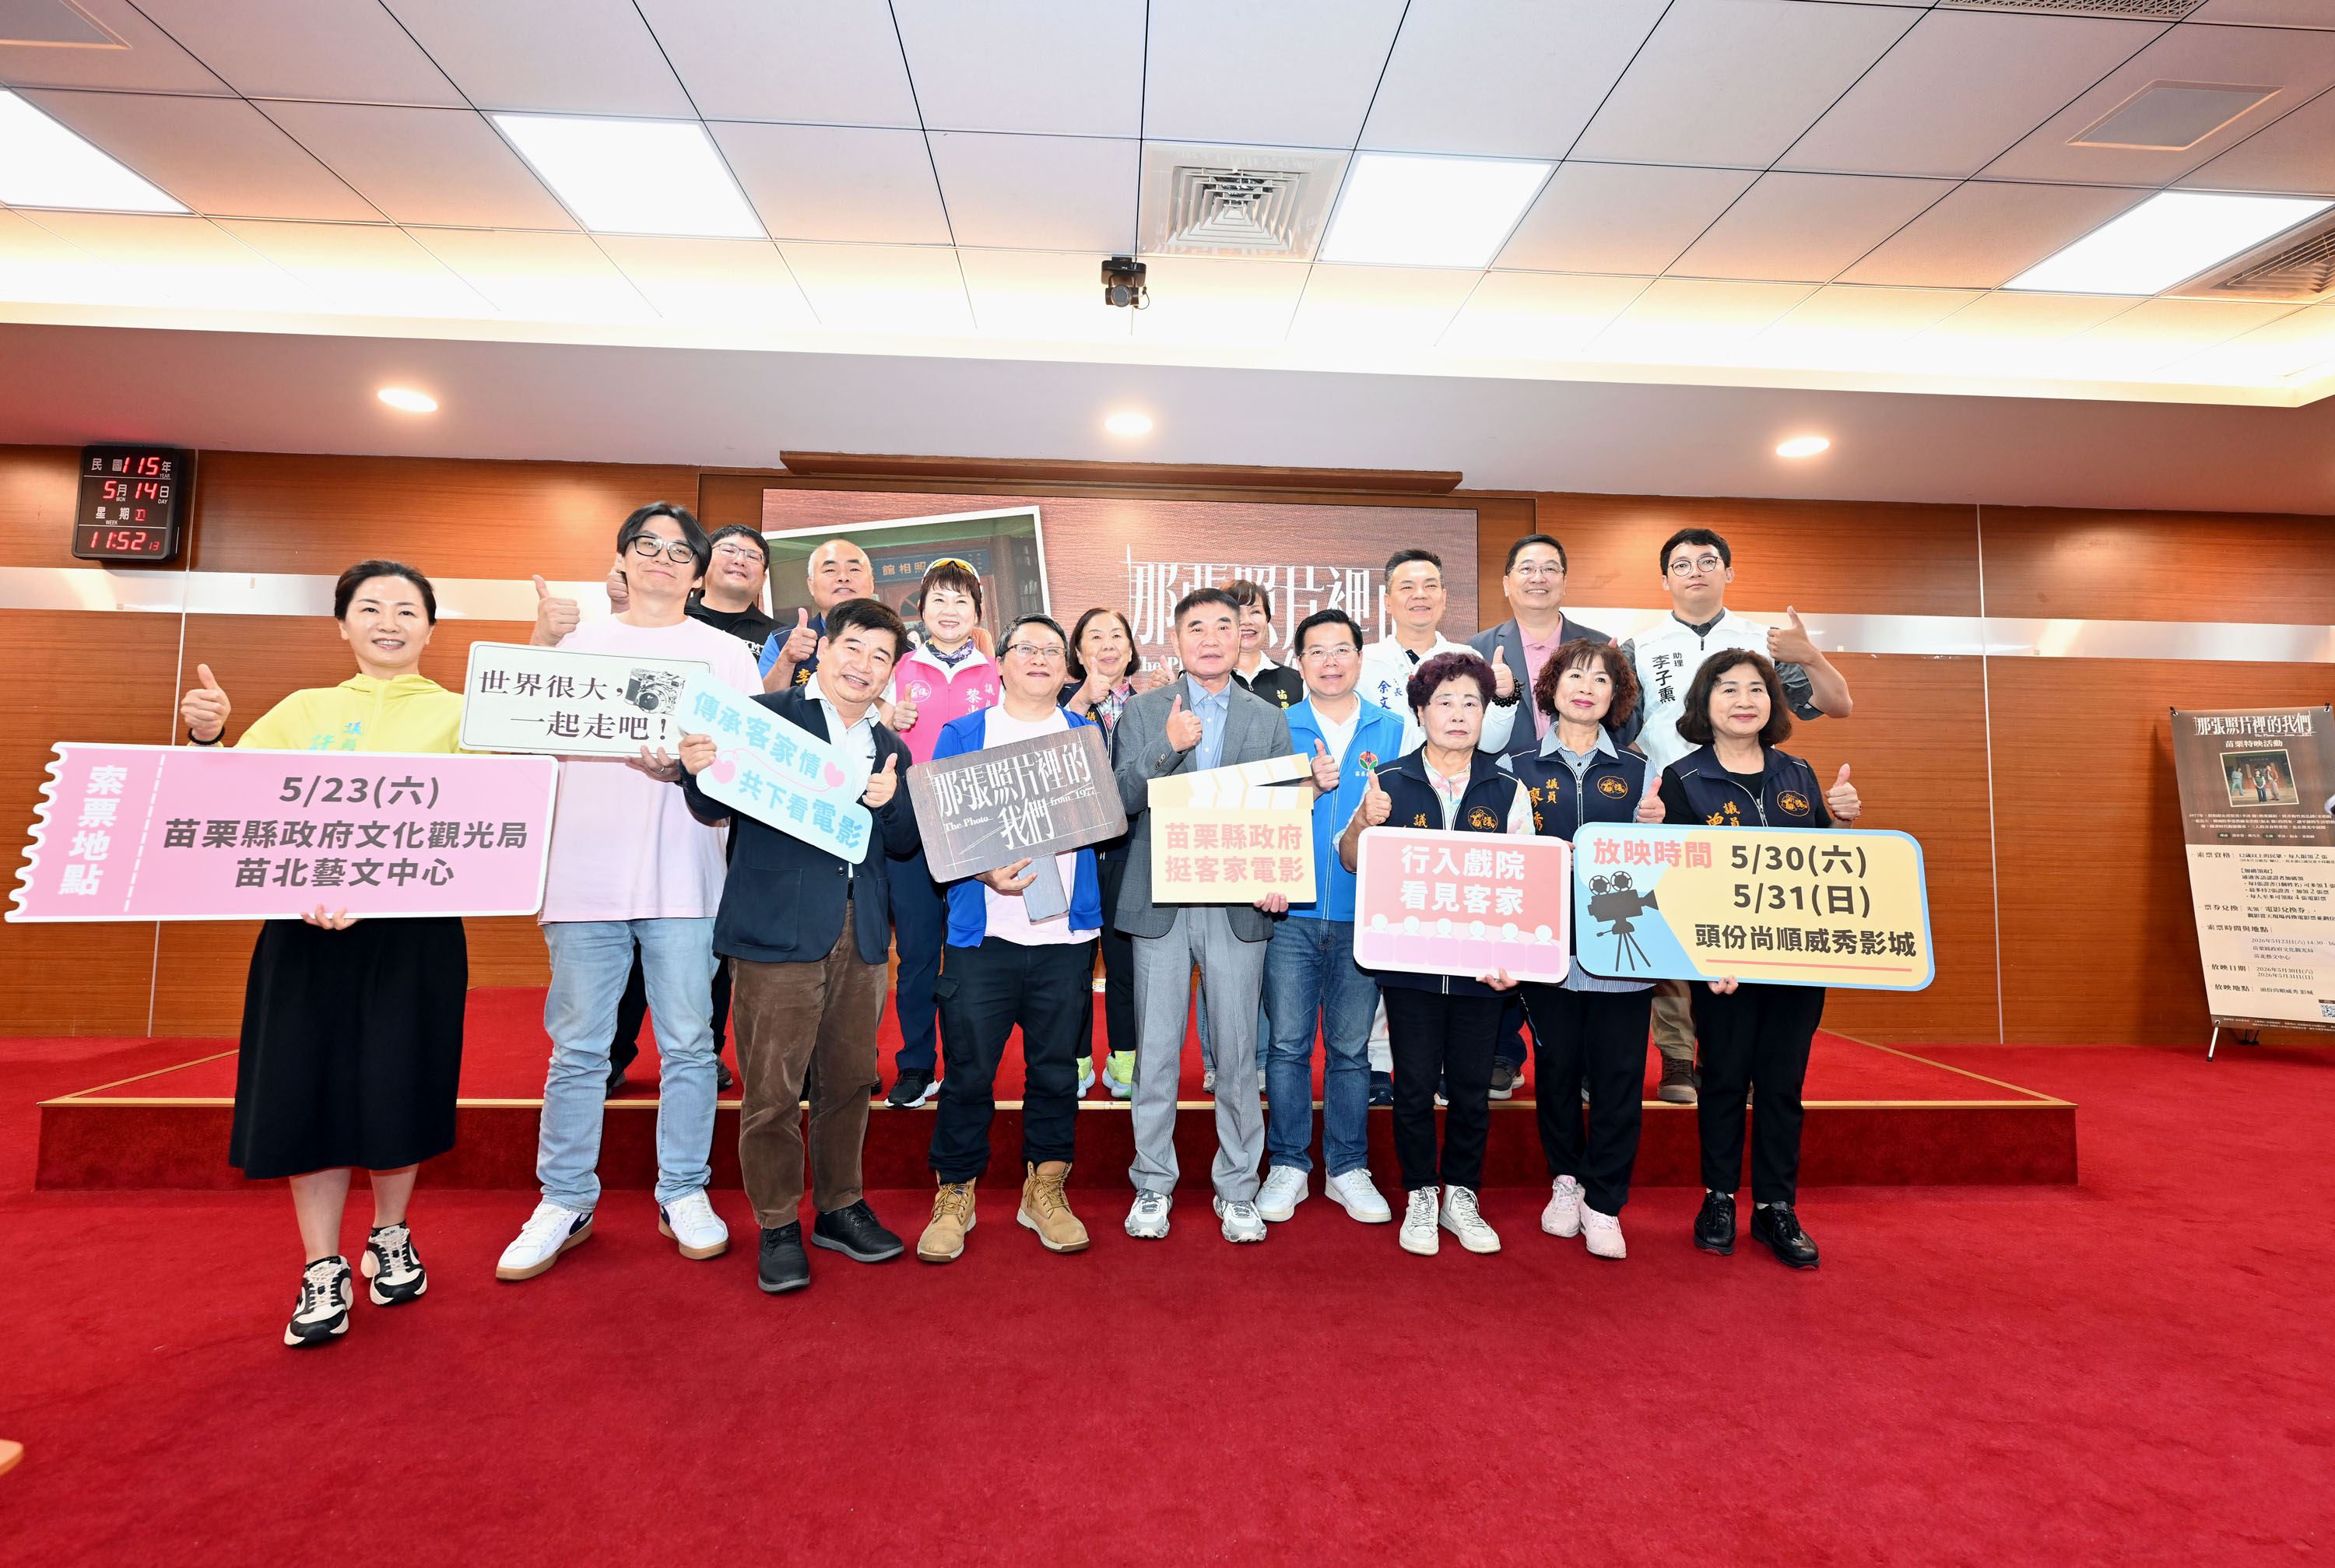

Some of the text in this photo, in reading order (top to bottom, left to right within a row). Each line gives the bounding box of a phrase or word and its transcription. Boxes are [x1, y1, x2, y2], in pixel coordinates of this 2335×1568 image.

[122, 457, 160, 475] 115
[102, 480, 170, 500] 5 月 14 日
[90, 531, 160, 551] 11:52 13
[1673, 652, 1684, 668] 助理
[693, 691, 821, 779] 傳承客家情
[2197, 712, 2312, 735] 那張照片裡的我們
[2224, 739, 2283, 748] 苗栗特映活動
[279, 775, 439, 809] 5/23(六)
[933, 743, 1092, 818] 那張照片裡的
[1545, 778, 1560, 804] 議員
[738, 770, 863, 848] 共下看電影
[944, 816, 990, 833] The Photo
[997, 797, 1056, 851] 我們
[58, 764, 128, 896] 索票地點
[163, 818, 528, 850] 苗栗縣政府文化觀光局
[1165, 823, 1302, 850] 苗栗縣政府
[235, 857, 455, 888] 苗北藝文中心
[1165, 856, 1304, 883] 挺客家電影
[1401, 844, 1526, 881] 行入戲院
[1593, 837, 1866, 879] 放映時間 5/30(六)
[1400, 880, 1524, 916] 看見客家
[1733, 883, 1870, 918] 5/31(日)
[1694, 924, 1917, 957] 頭份尚順威秀影城
